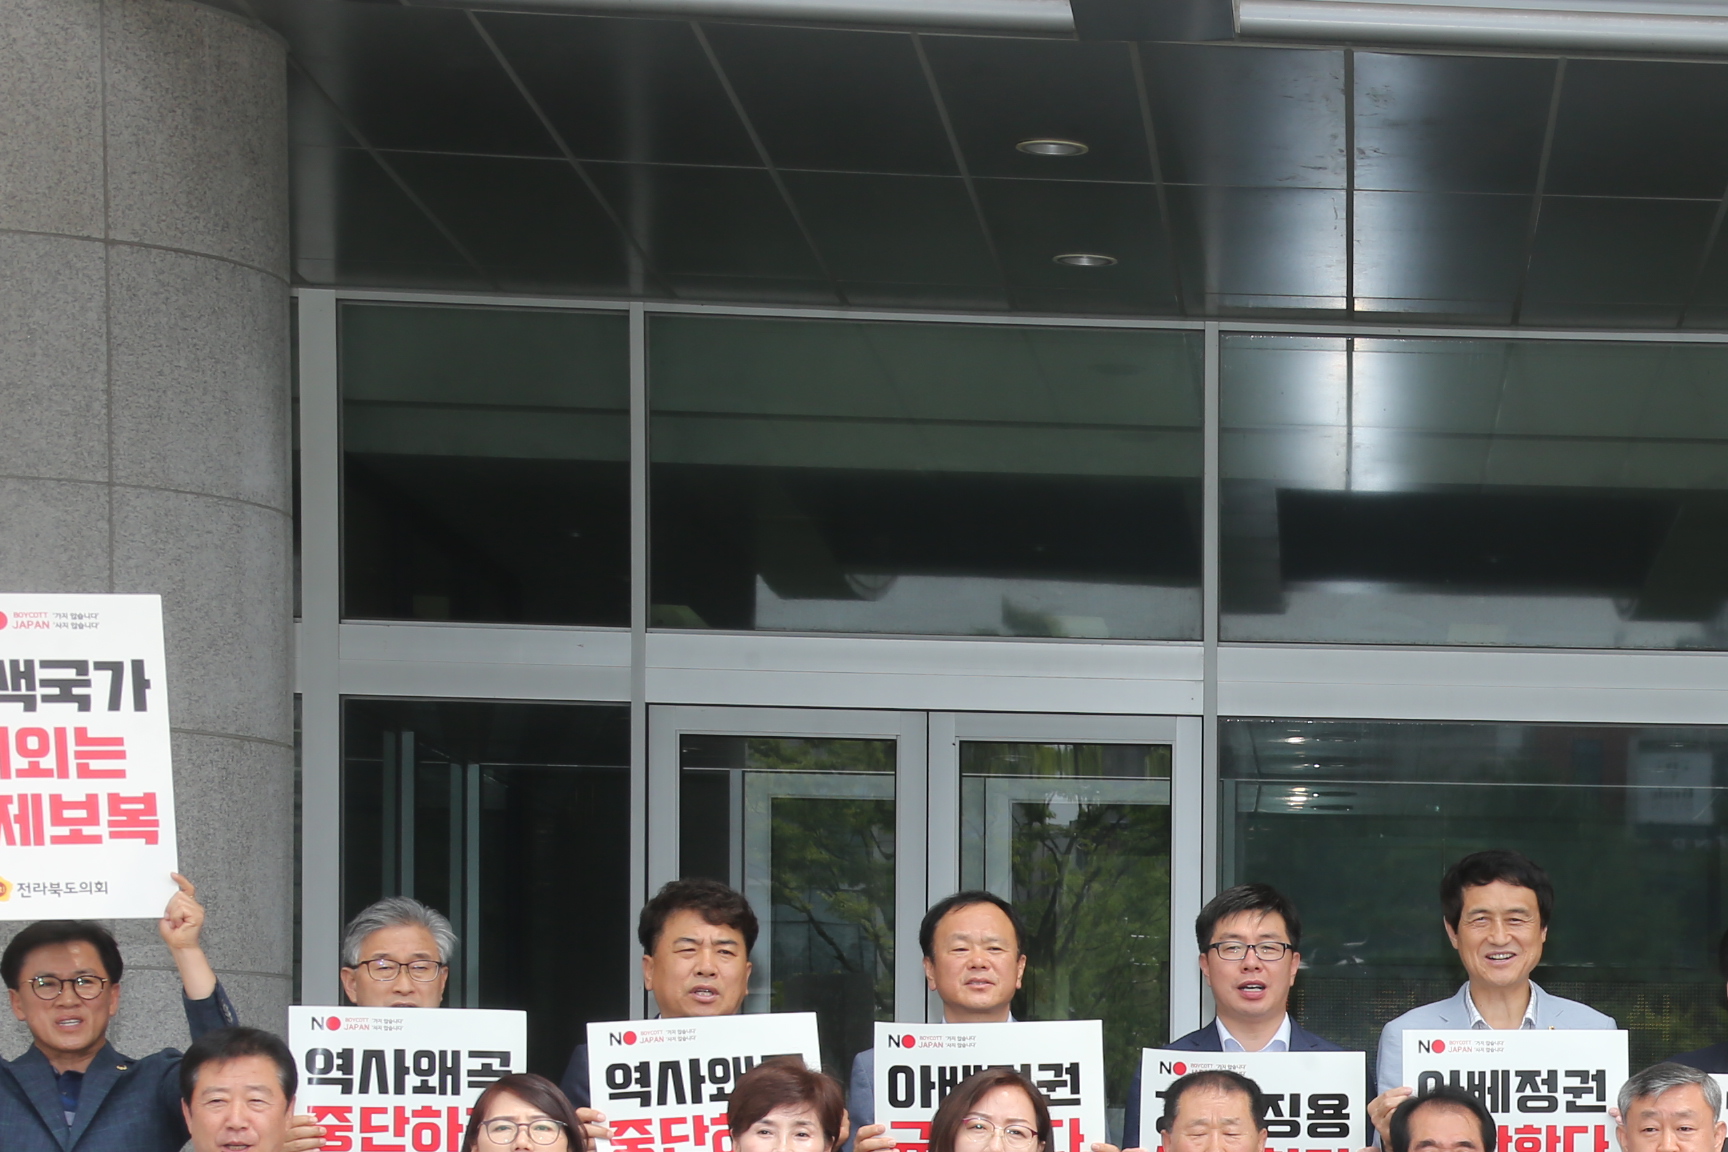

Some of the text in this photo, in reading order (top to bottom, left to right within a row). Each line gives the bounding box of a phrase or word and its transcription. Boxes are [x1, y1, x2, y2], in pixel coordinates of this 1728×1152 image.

[12, 620, 50, 629] JAPAN
[0, 726, 127, 779] 외는
[17, 880, 109, 898] 전라북도의회
[344, 1023, 370, 1031] JAPAN
[640, 1036, 664, 1044] JAPAN
[305, 1048, 512, 1095] 역사왜곡
[605, 1053, 803, 1107] 역사왜
[307, 1105, 474, 1152] 중단하
